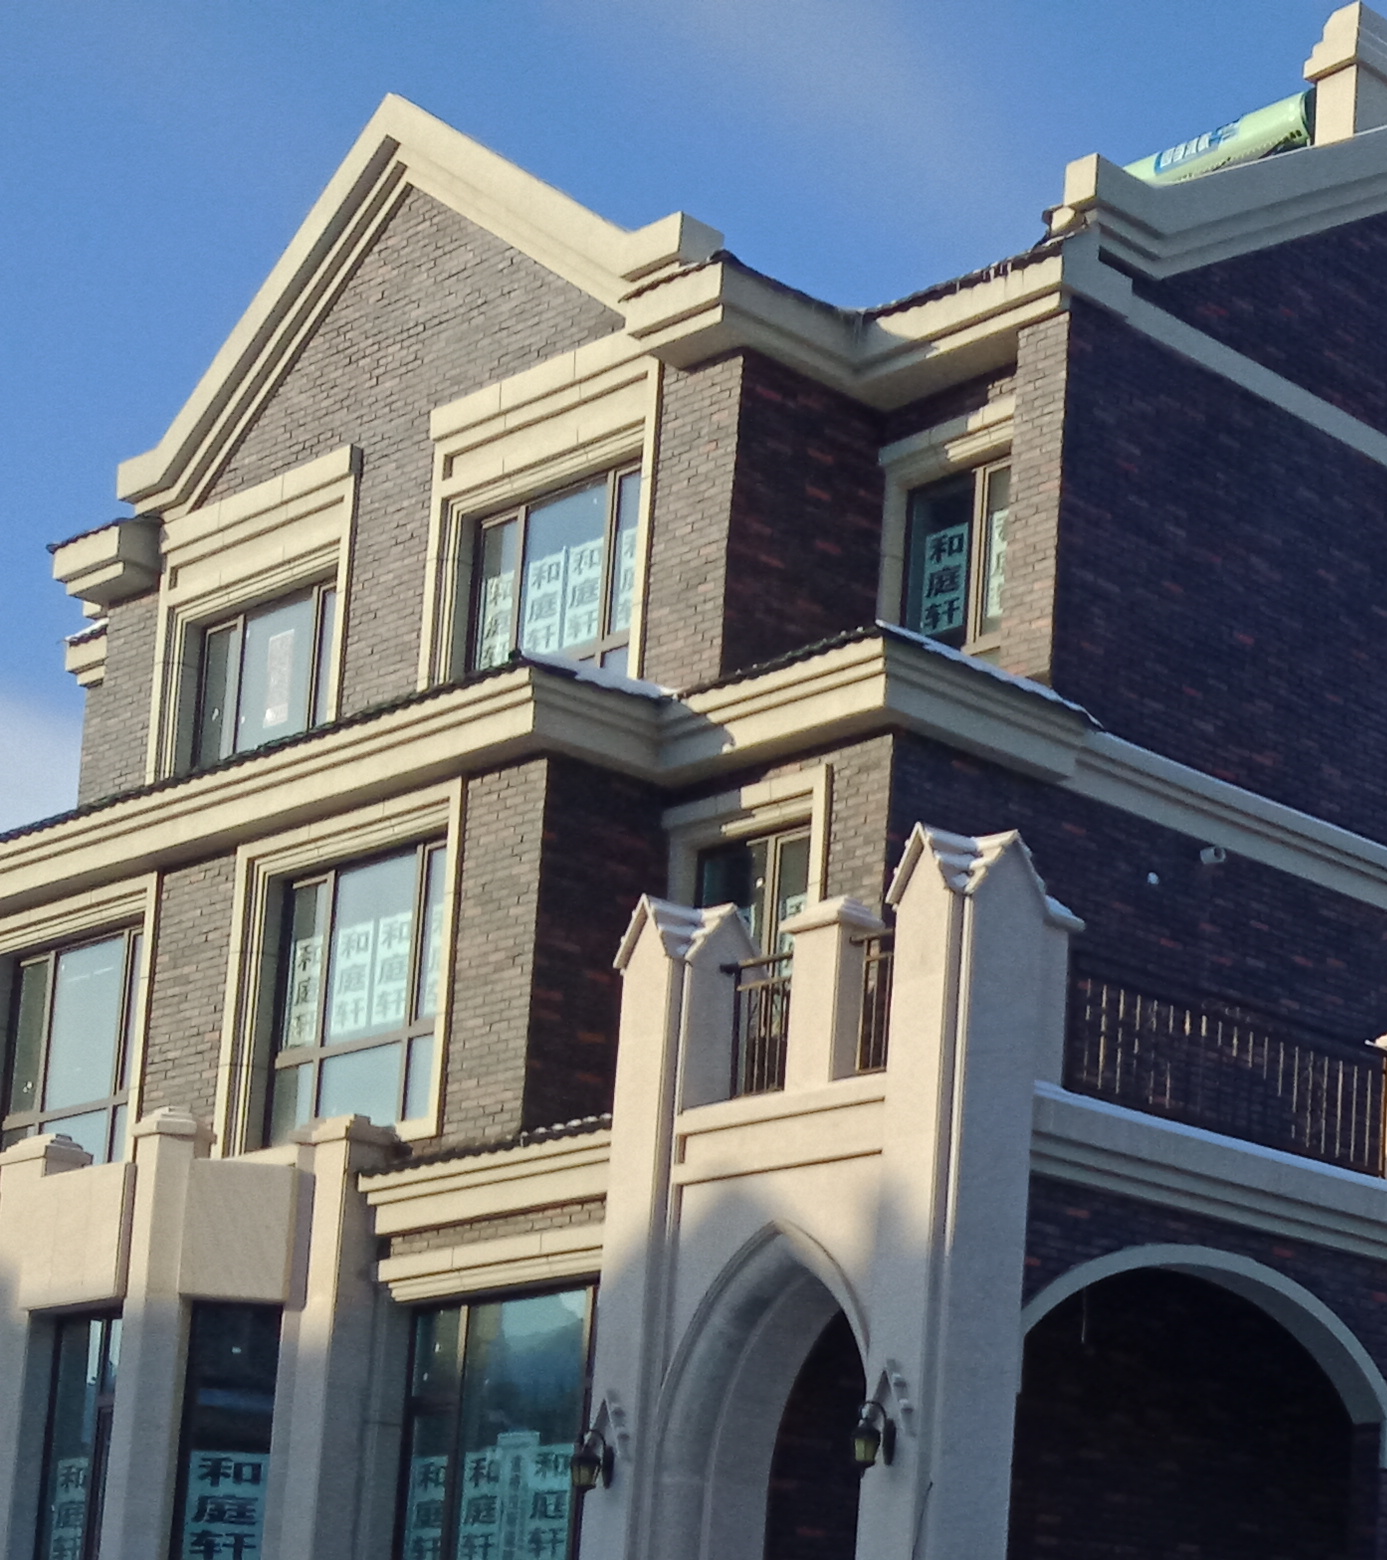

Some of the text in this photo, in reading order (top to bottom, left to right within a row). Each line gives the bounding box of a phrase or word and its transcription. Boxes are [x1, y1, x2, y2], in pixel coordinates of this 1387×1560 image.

[528, 560, 562, 651] 和庭轩
[926, 532, 964, 630] 和庭轩
[335, 930, 369, 1029] 和庭轩
[374, 918, 410, 1021] 和庭轩
[528, 1452, 570, 1559] 和庭轩
